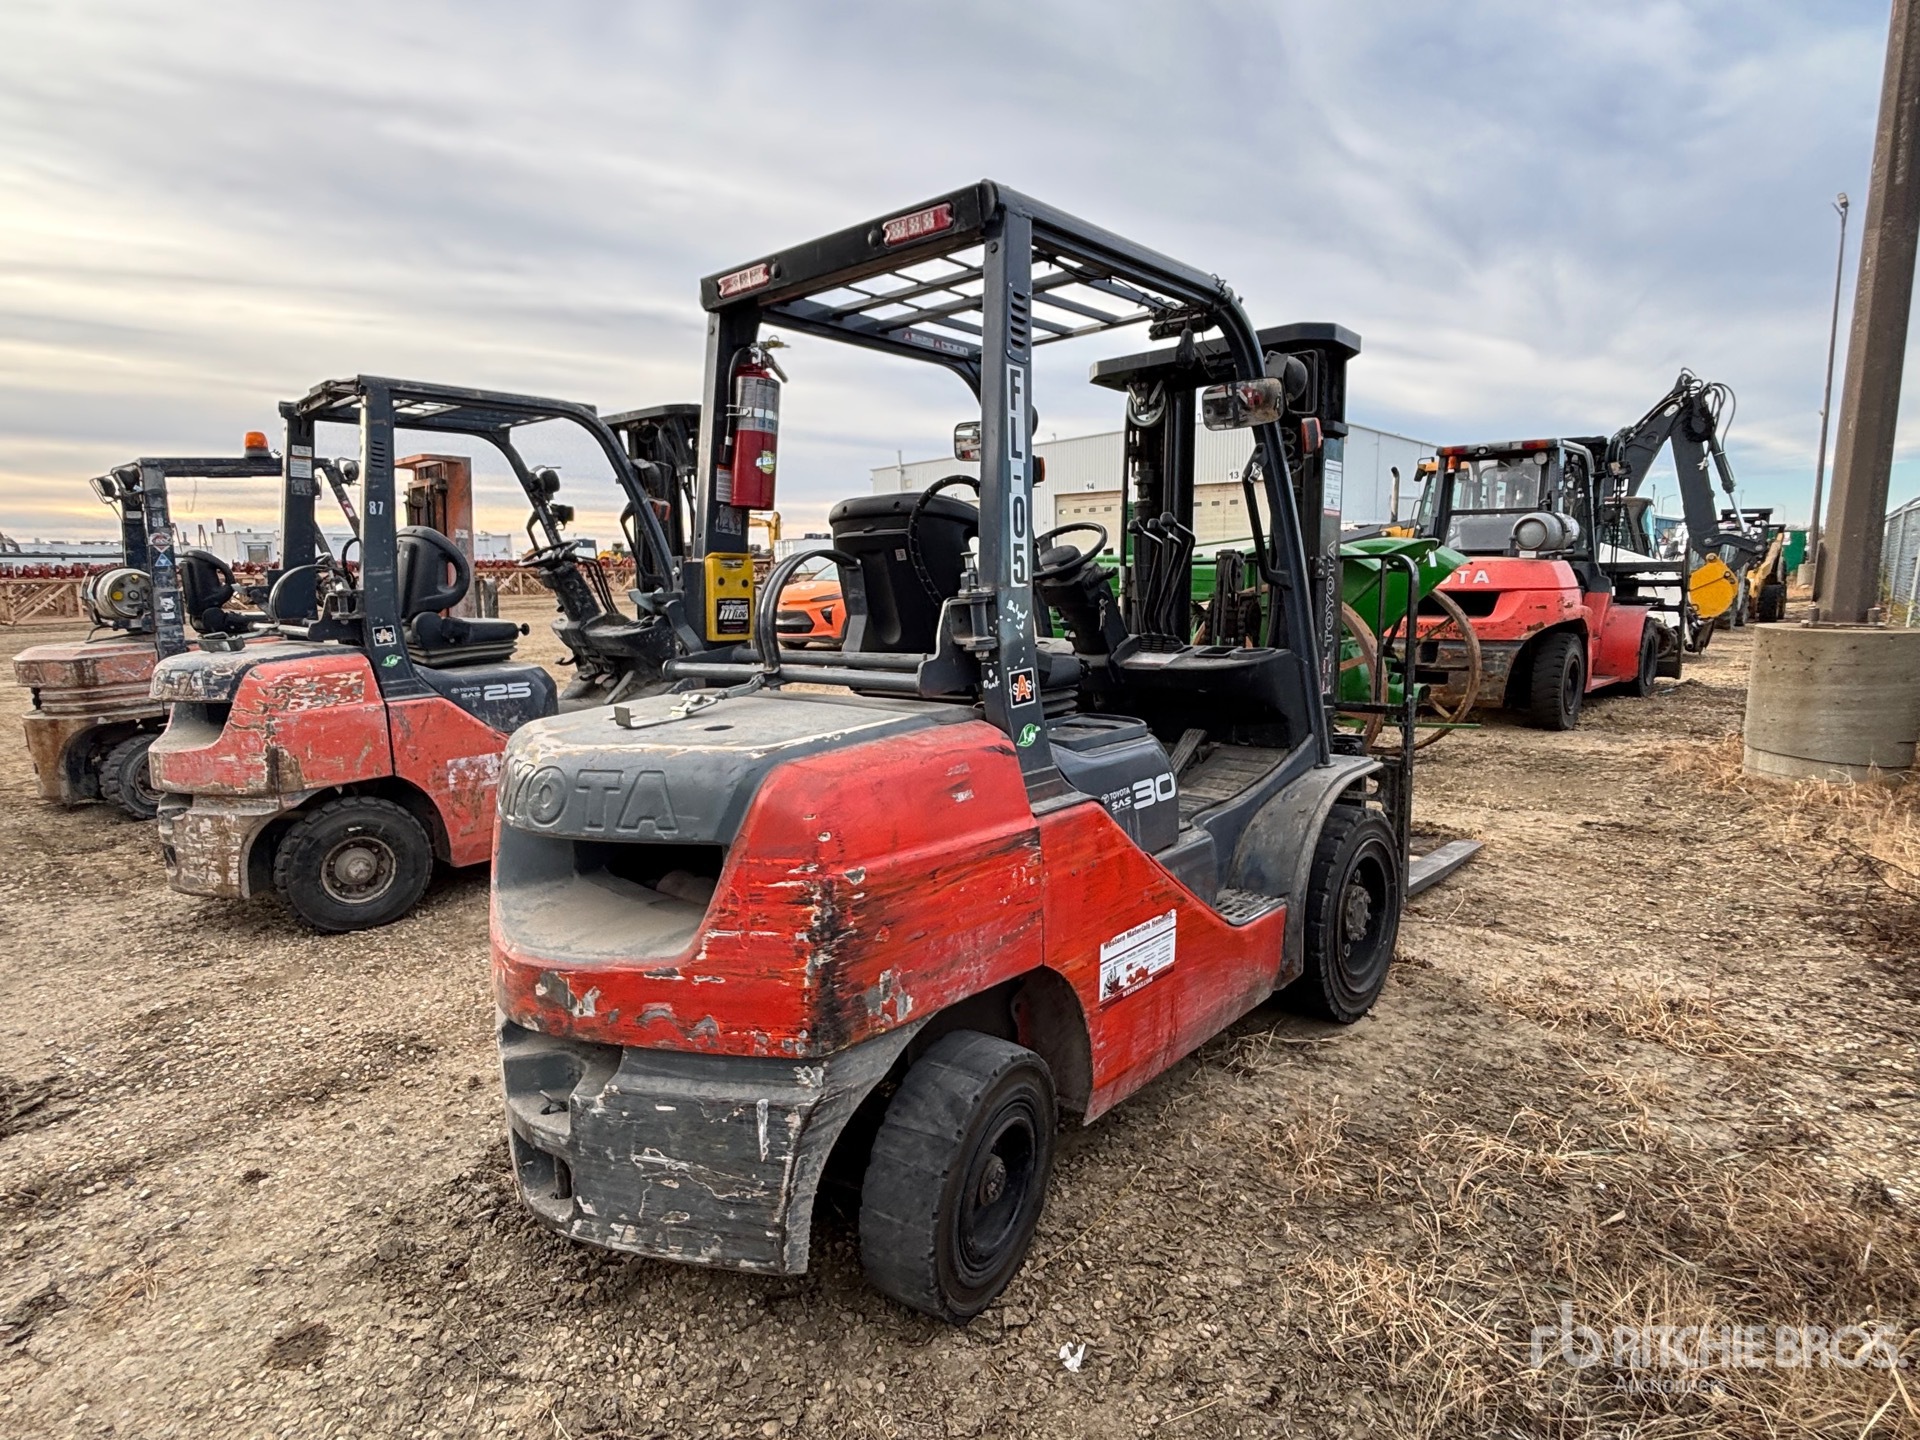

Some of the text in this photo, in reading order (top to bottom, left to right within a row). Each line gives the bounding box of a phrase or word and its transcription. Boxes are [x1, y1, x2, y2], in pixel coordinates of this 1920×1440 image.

[1009, 368, 1026, 585] FL-05
[1229, 472, 1240, 480] 13
[1085, 483, 1095, 491] 14
[368, 501, 384, 515] 87
[1324, 540, 1337, 648] TOYOTA
[484, 682, 532, 701] 25
[1109, 787, 1131, 800] TOYOTA
[1132, 771, 1176, 810] 30
[1111, 797, 1131, 811] SAS
[1103, 935, 1126, 950] Western
[1127, 924, 1151, 940] Materials
